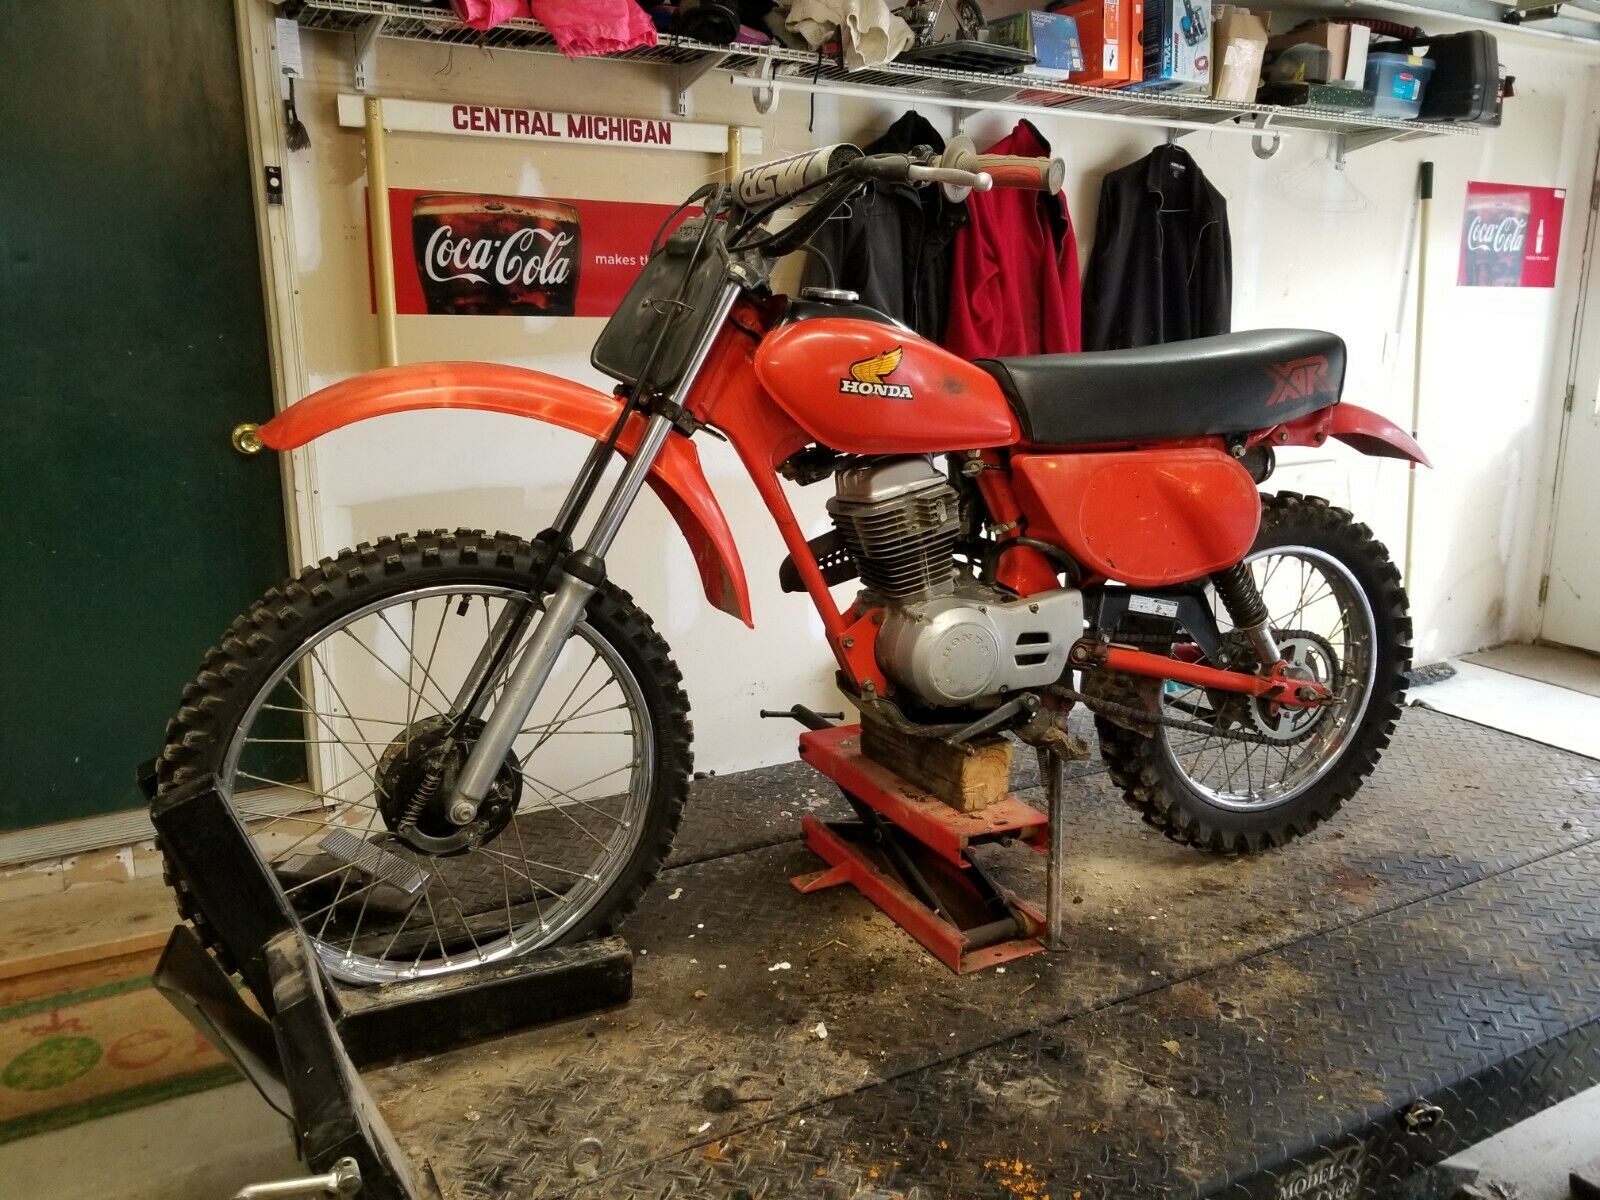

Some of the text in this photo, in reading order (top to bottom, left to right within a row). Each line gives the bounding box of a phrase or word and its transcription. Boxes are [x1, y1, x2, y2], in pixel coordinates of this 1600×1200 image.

[453, 105, 671, 145] CENTRAL MICHIGAN
[1467, 215, 1528, 253] Coca-Cola
[425, 224, 575, 286] Coca-Cola
[595, 254, 636, 266] makes
[840, 380, 914, 399] HONDA
[1263, 355, 1330, 407] XR
